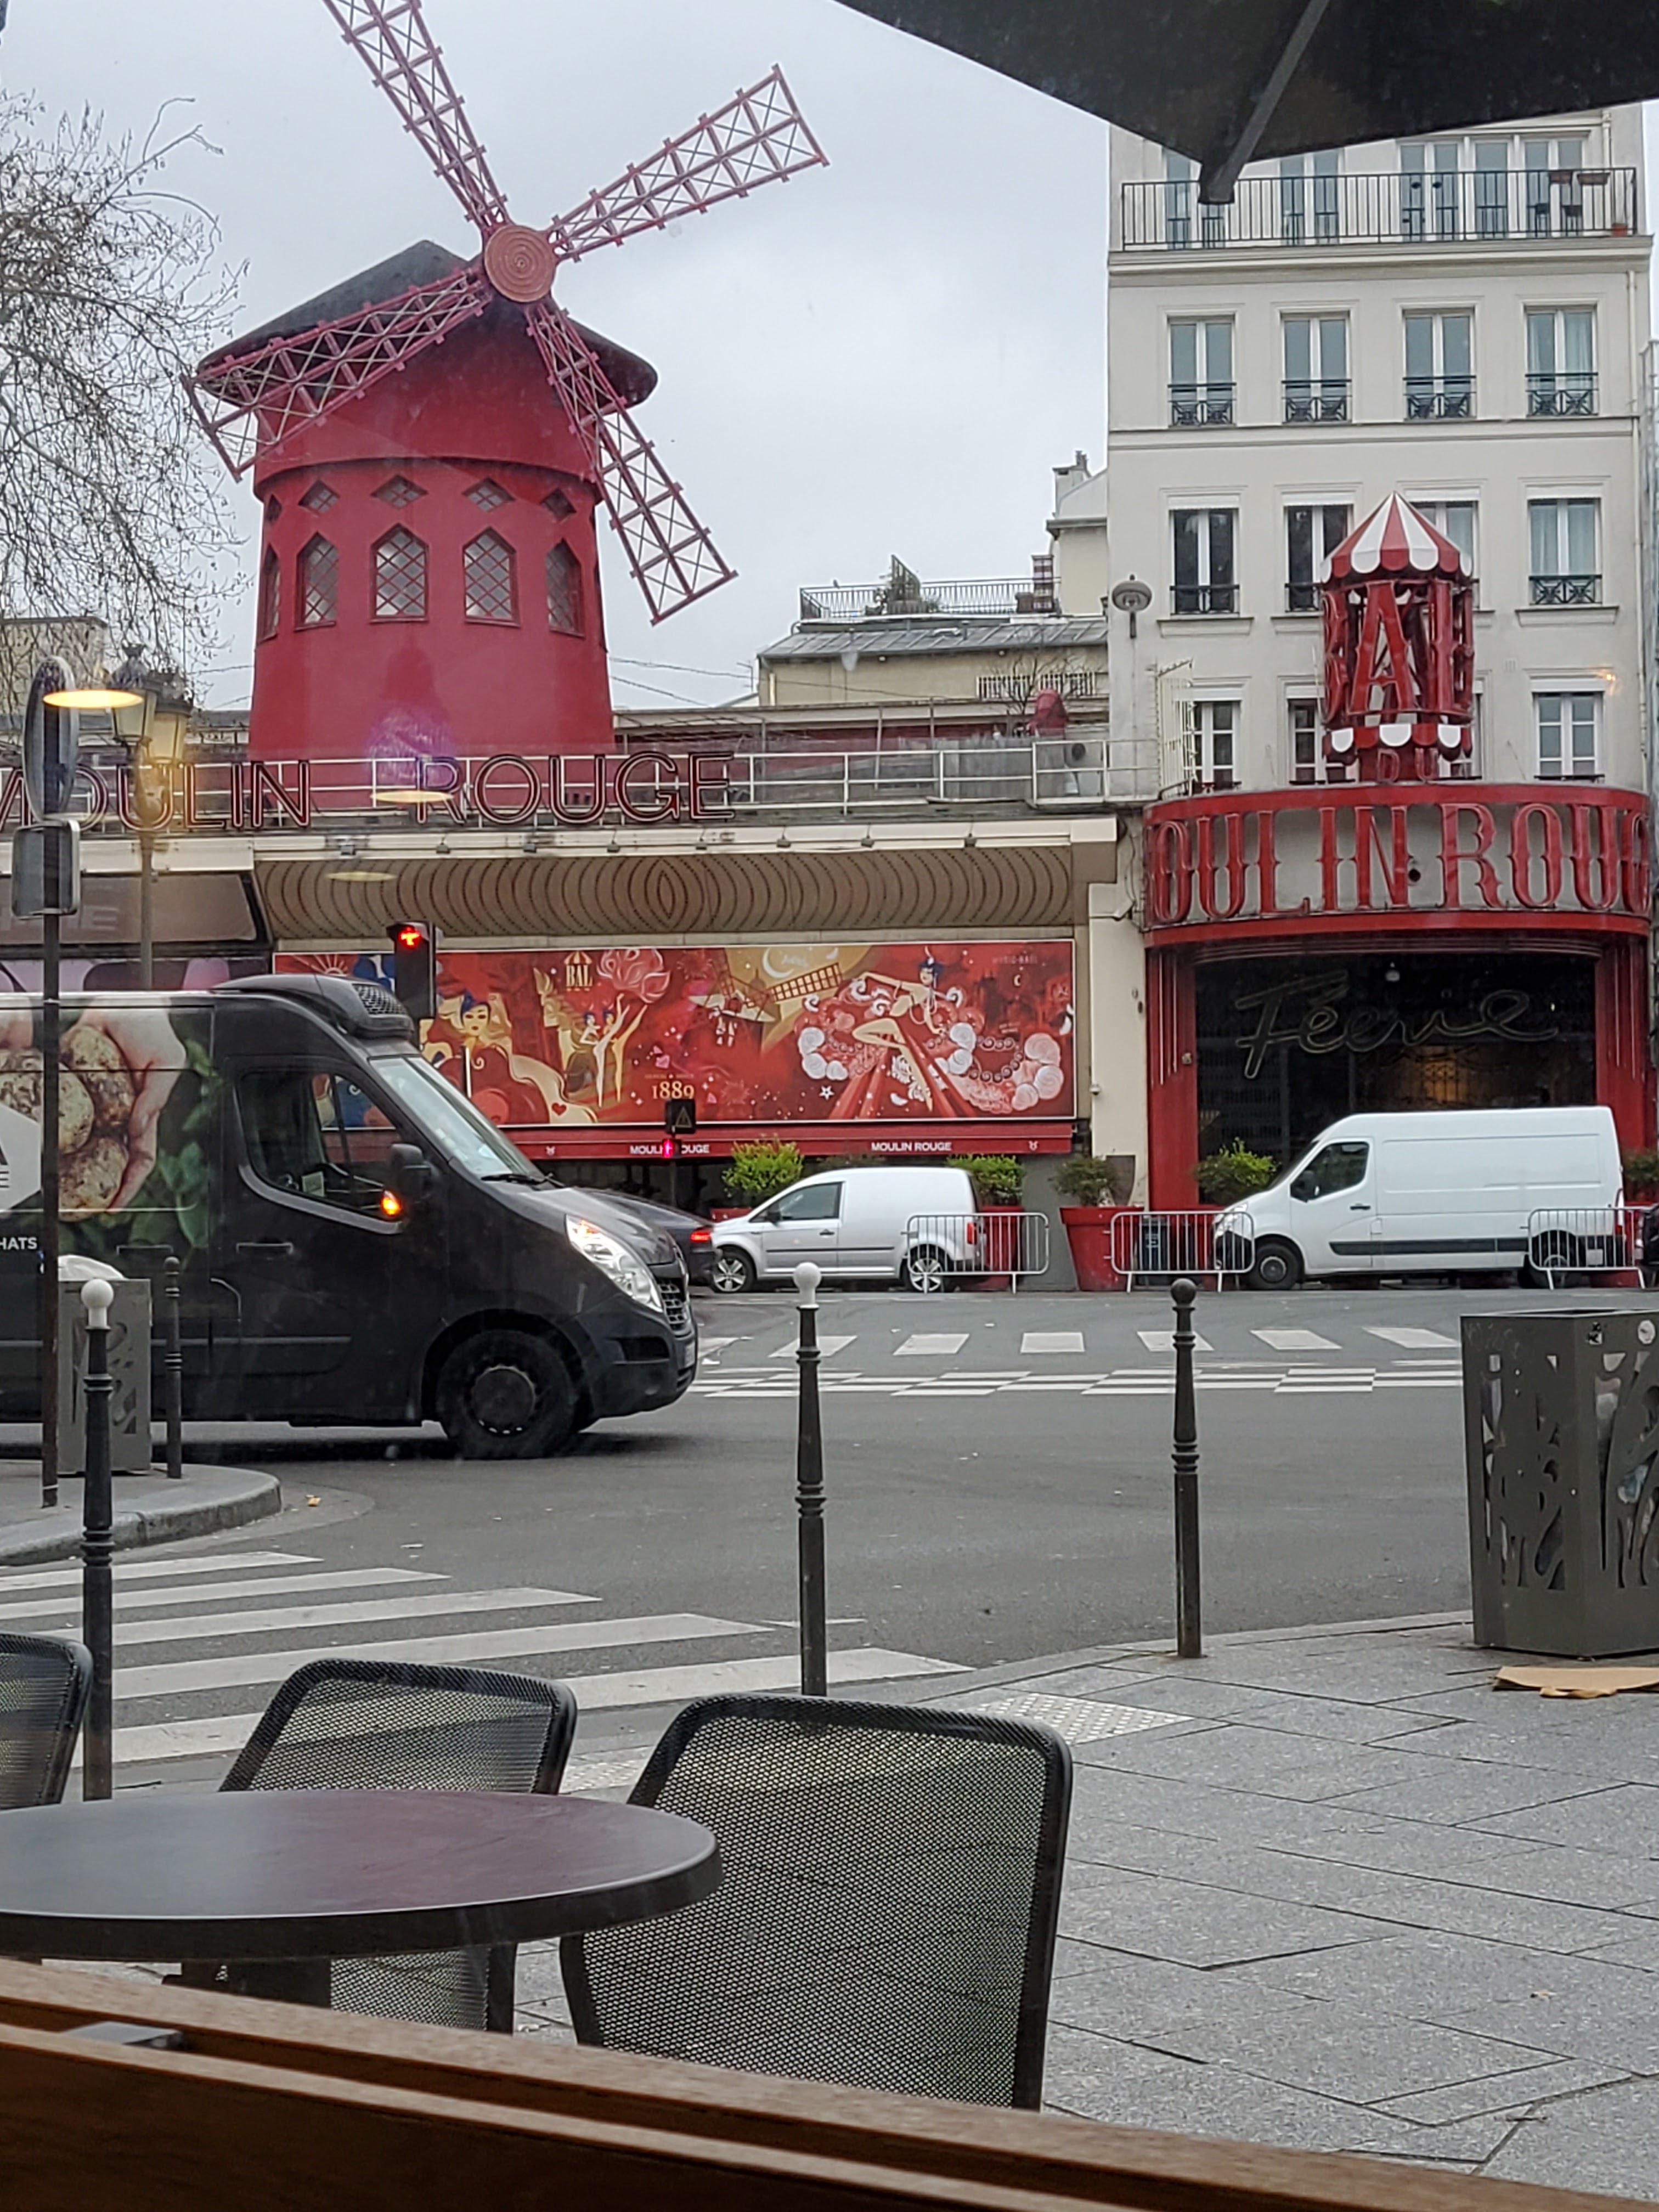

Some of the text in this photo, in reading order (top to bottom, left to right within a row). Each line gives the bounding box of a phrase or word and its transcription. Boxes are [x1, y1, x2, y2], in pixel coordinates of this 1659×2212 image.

[1376, 748, 1438, 784] DU
[414, 751, 735, 825] ROUGE
[1144, 804, 1412, 924] OULIN
[566, 964, 593, 987] BAL
[652, 1081, 695, 1099] 1889
[630, 1144, 710, 1155] MOULI OUGE
[871, 1142, 952, 1152] MOULIN ROUGE
